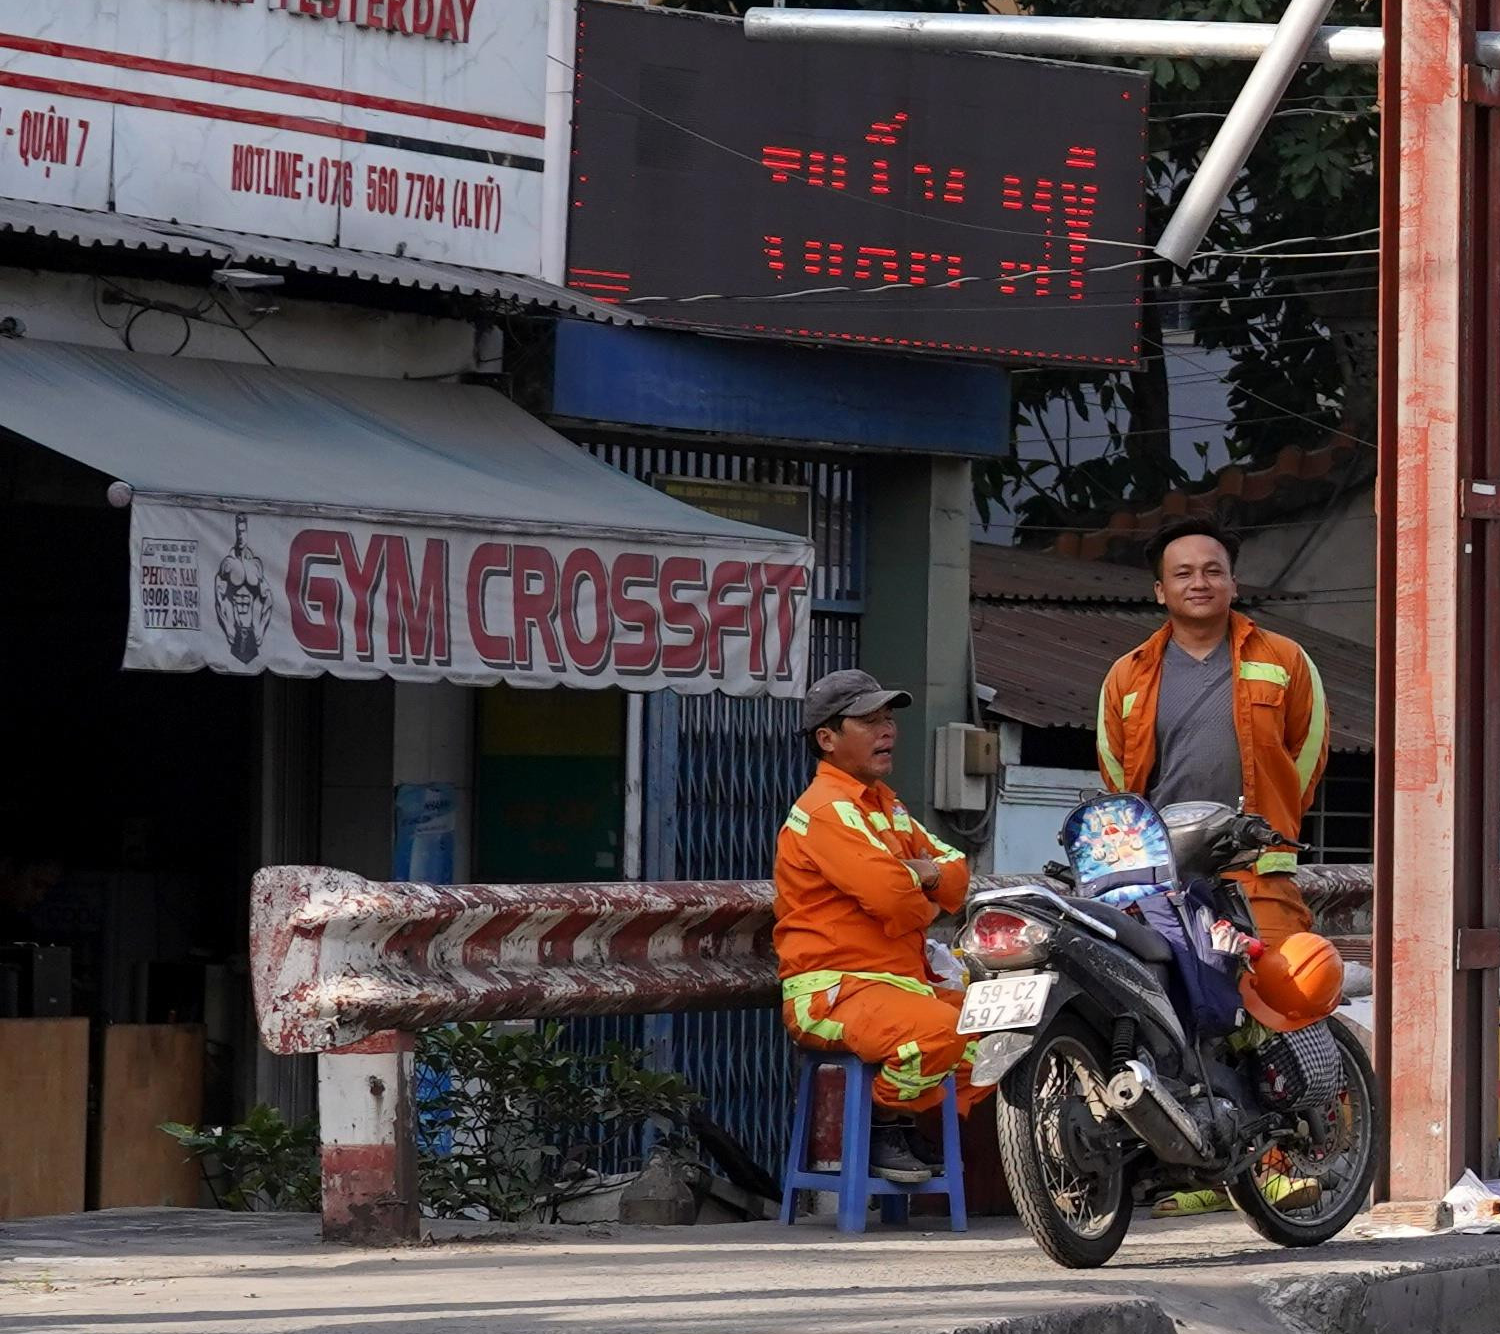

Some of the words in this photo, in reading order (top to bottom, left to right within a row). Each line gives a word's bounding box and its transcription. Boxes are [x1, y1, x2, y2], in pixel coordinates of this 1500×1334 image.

[19, 105, 70, 178] QUẬN
[75, 120, 90, 168] 7
[366, 166, 398, 216] 560
[405, 172, 445, 222] 7794
[142, 588, 169, 607] 0908
[286, 528, 453, 666] GYM
[466, 541, 808, 683] CROSSFIT
[978, 981, 1037, 1005] 59-C2
